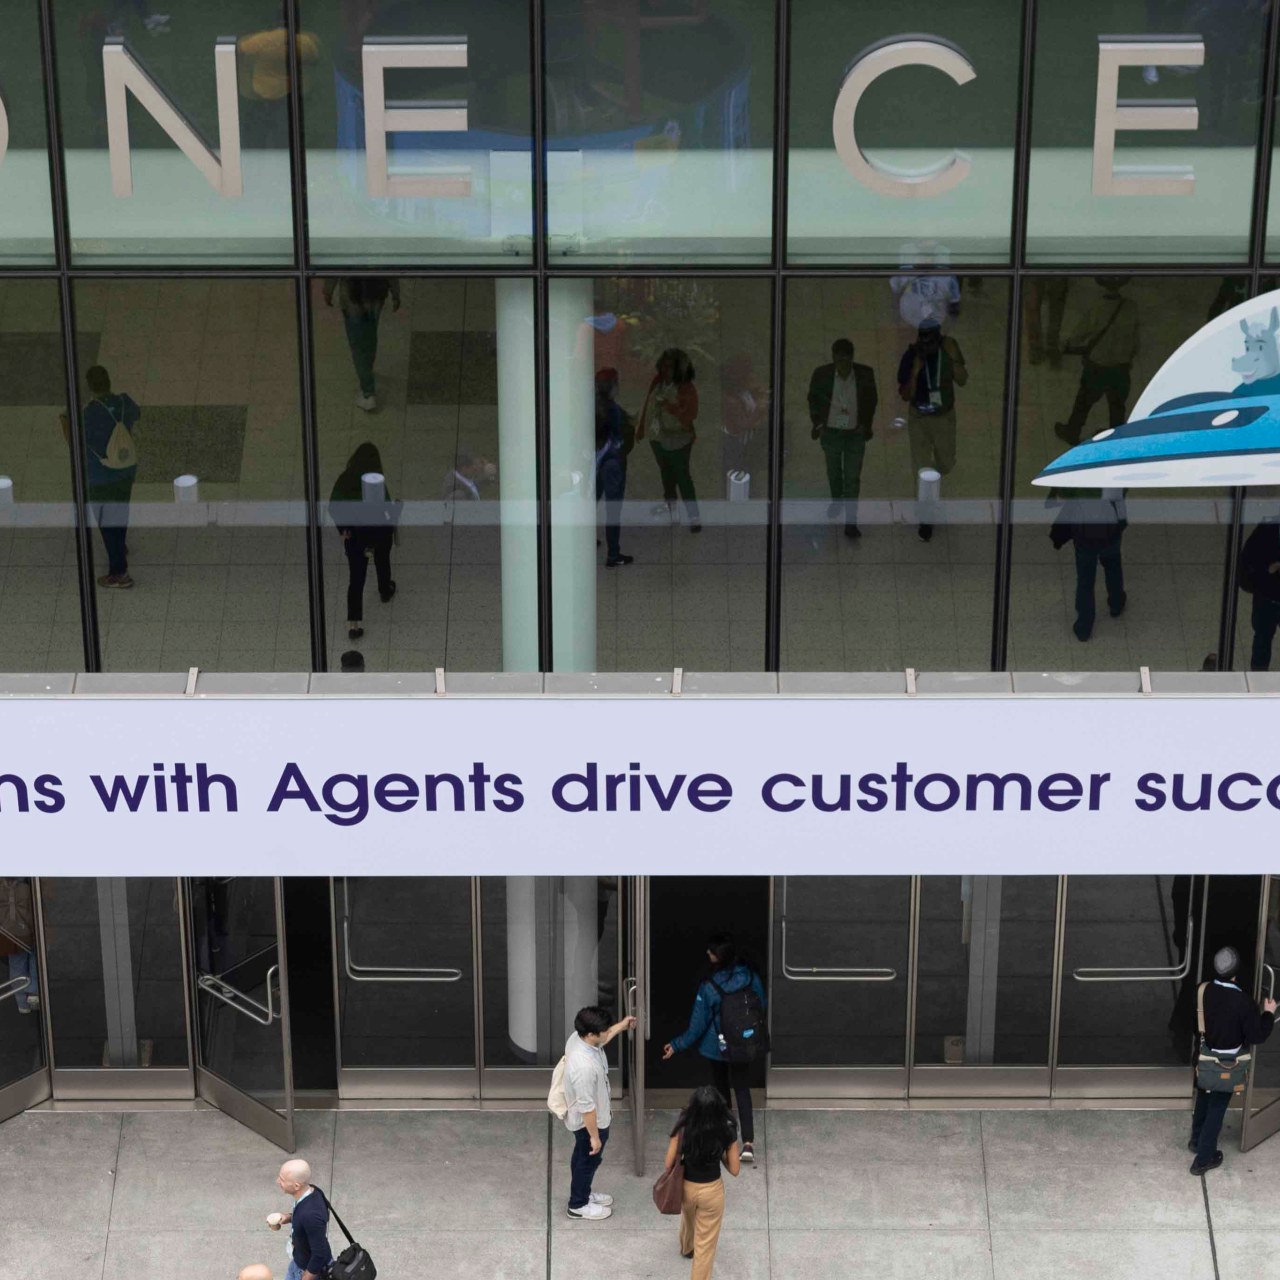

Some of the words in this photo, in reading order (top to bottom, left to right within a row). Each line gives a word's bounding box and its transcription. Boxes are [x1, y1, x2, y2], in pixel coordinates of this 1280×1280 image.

[90, 762, 239, 813] with
[267, 762, 525, 826] Agents
[551, 762, 733, 813] drive
[761, 762, 1111, 813] customer
